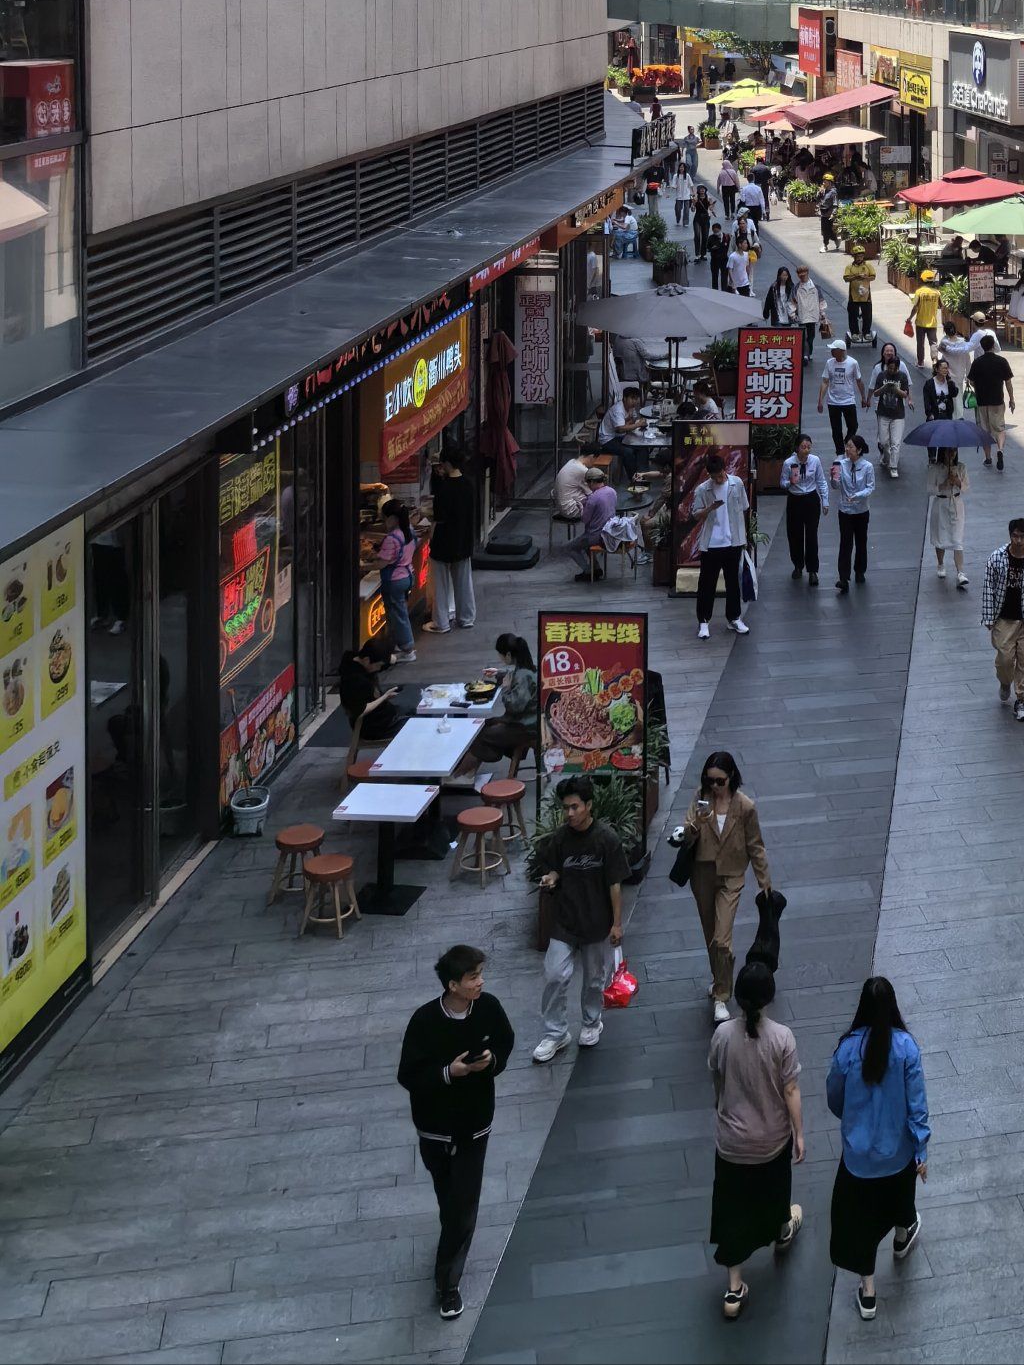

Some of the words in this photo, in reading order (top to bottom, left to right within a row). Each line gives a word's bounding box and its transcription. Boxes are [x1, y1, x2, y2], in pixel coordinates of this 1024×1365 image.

[519, 294, 551, 308] 正宗
[744, 334, 796, 345] 正宗柳州
[521, 316, 551, 402] 螺蛳粉
[745, 347, 794, 419] 螺蛳粉
[545, 622, 641, 644] 香港米线
[544, 651, 571, 674] 18
